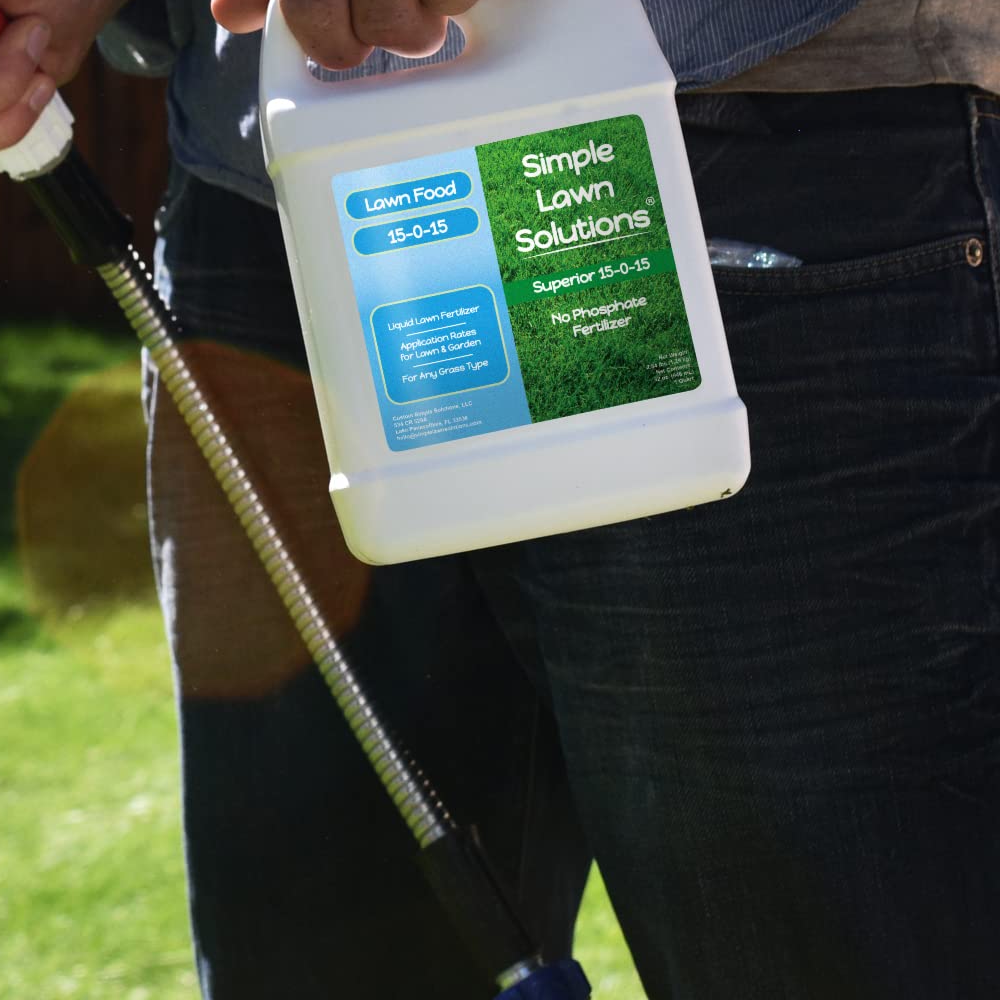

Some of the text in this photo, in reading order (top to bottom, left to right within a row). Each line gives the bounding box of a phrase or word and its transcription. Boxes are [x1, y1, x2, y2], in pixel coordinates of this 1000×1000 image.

[521, 139, 615, 178] Simple
[364, 179, 457, 212] Lawn Food
[535, 180, 615, 213] Lawn
[387, 219, 449, 244] 15-0-15
[515, 209, 651, 253] Solutions
[532, 257, 651, 294] Superior 15-0-15
[387, 305, 480, 331] Liquid Lawn Fertilizer
[551, 296, 648, 325] No Phosphate
[573, 315, 632, 338] Fertilizer
[400, 328, 477, 352] Application Rates
[400, 338, 482, 362] for Lawn & Garden
[402, 359, 489, 384] For Any Grass Type
[461, 400, 473, 408] LLC
